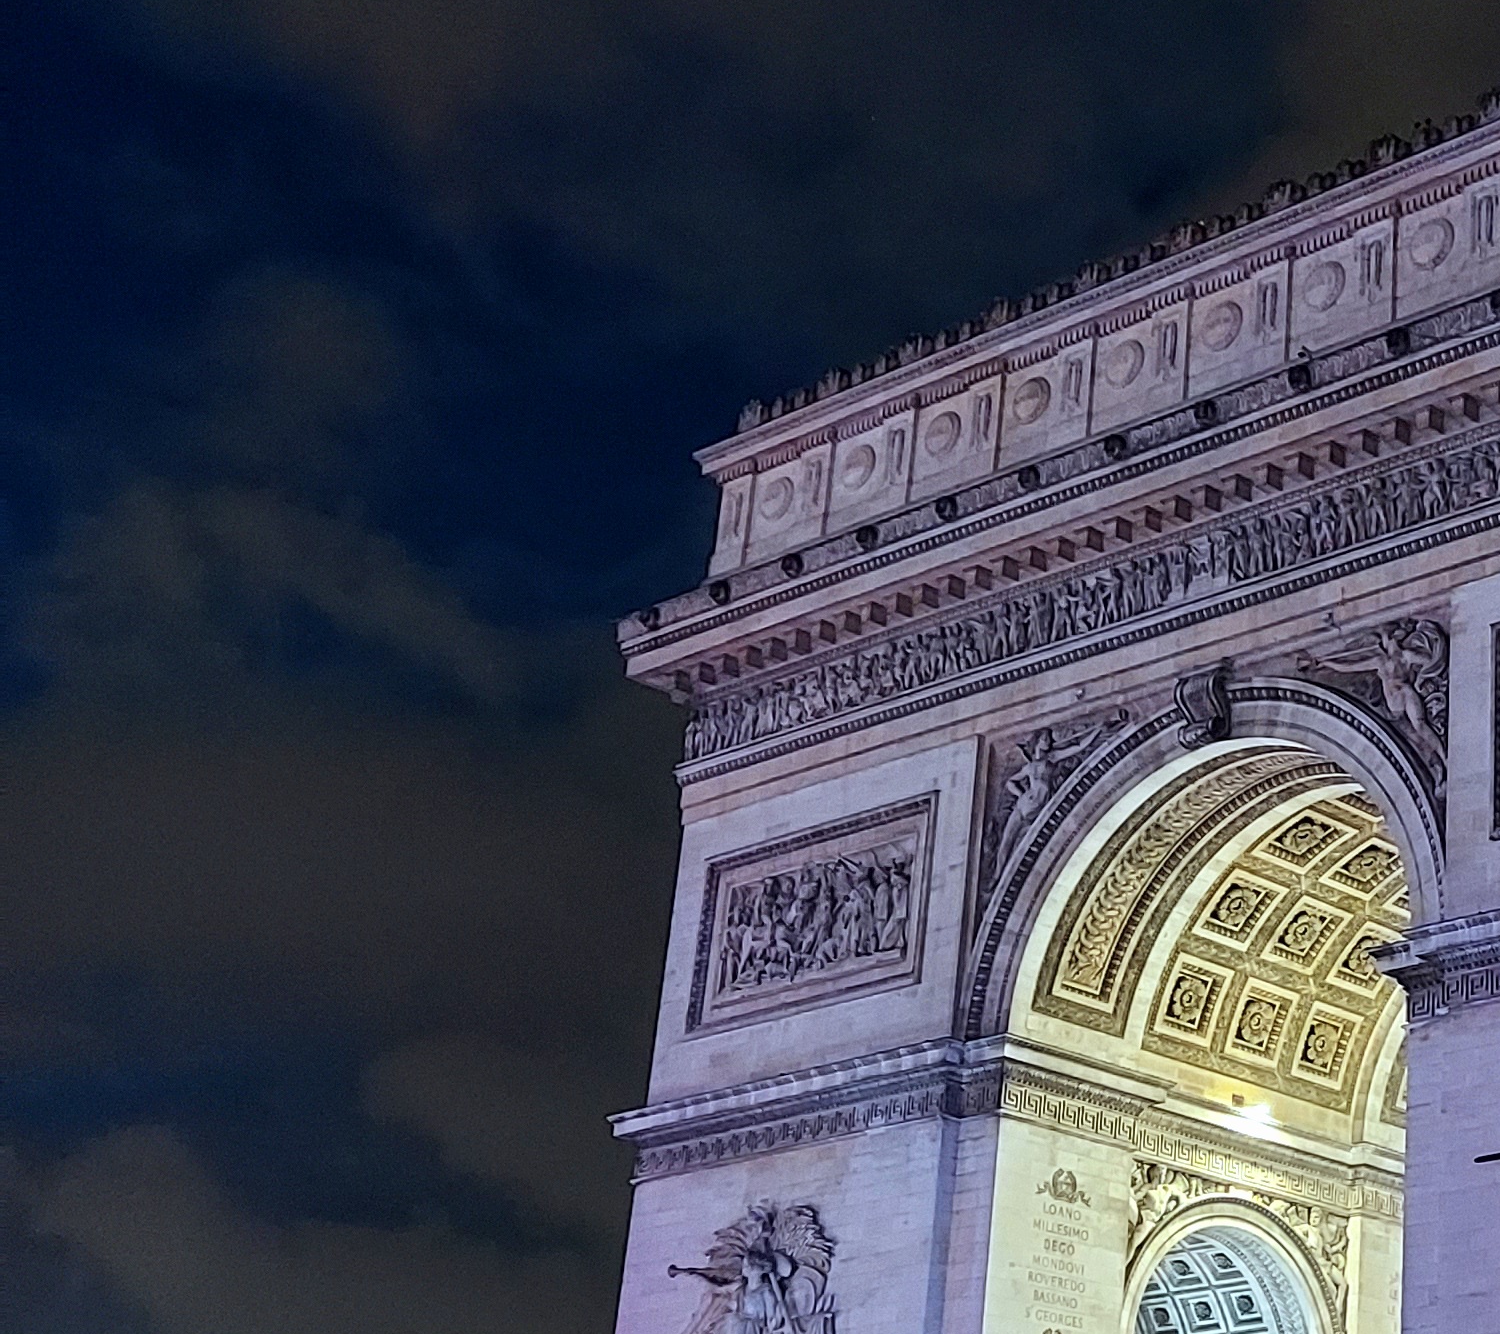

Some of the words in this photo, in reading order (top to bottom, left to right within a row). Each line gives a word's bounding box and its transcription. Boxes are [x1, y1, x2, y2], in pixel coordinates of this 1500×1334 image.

[1043, 1202, 1082, 1221] LOANO
[1033, 1218, 1089, 1242] MILLESIMO
[1043, 1238, 1076, 1256] DEGO
[1032, 1254, 1085, 1276] MONDOVI
[1028, 1270, 1086, 1294] ROVEREDO
[1033, 1289, 1078, 1309] BASSANO
[1035, 1309, 1083, 1329] GEORGES
